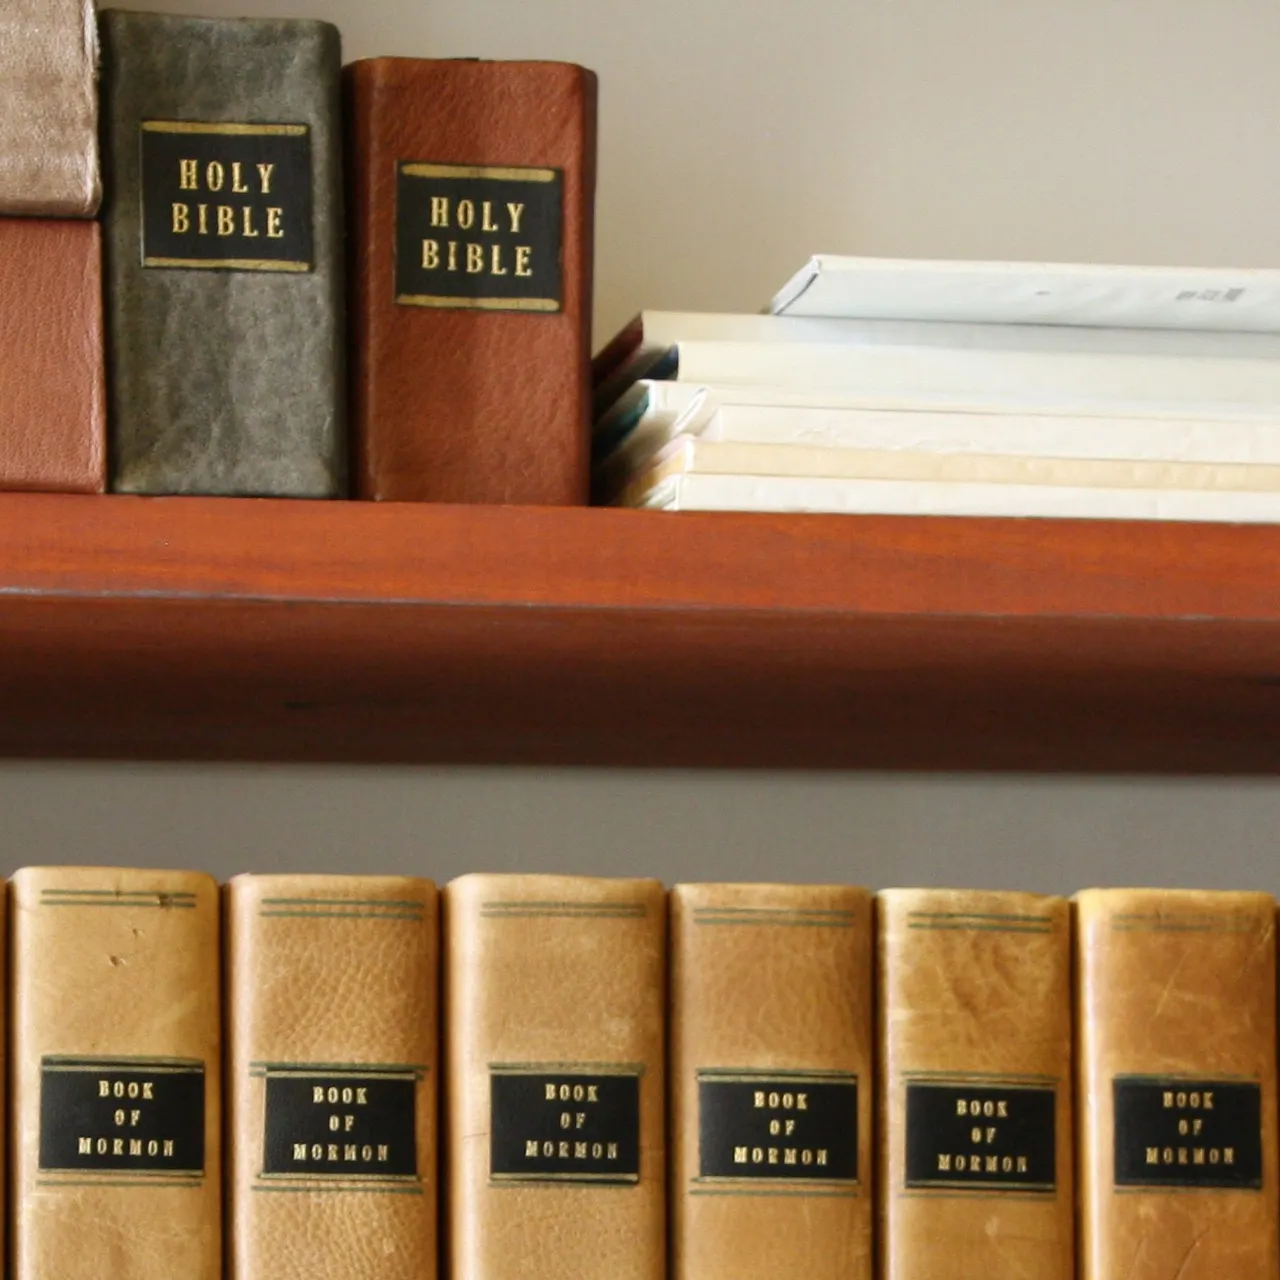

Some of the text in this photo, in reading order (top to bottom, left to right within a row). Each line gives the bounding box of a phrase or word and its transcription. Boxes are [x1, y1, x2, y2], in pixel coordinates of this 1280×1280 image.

[180, 159, 274, 194] HOLY
[172, 202, 284, 238] BIBLE
[431, 196, 524, 233] HOLY
[422, 239, 533, 277] BIBLE
[98, 1079, 153, 1099] BOOK
[313, 1086, 367, 1104] BOOK
[545, 1083, 597, 1102] BOOK
[754, 1091, 807, 1110] BOOK
[956, 1099, 1008, 1117] BOOK
[1163, 1091, 1213, 1109] BOOK
[114, 1108, 141, 1126] OF
[328, 1115, 354, 1132] OF
[560, 1112, 586, 1129] OF
[769, 1119, 795, 1136] OF
[971, 1127, 996, 1144] OF
[1178, 1118, 1203, 1135] OF
[78, 1137, 173, 1157] MORMON
[293, 1143, 388, 1161] MORMON
[525, 1139, 617, 1159] MORMON
[733, 1146, 827, 1165] MORMON
[1145, 1147, 1234, 1164] MORMON
[938, 1153, 1027, 1172] MORMON
